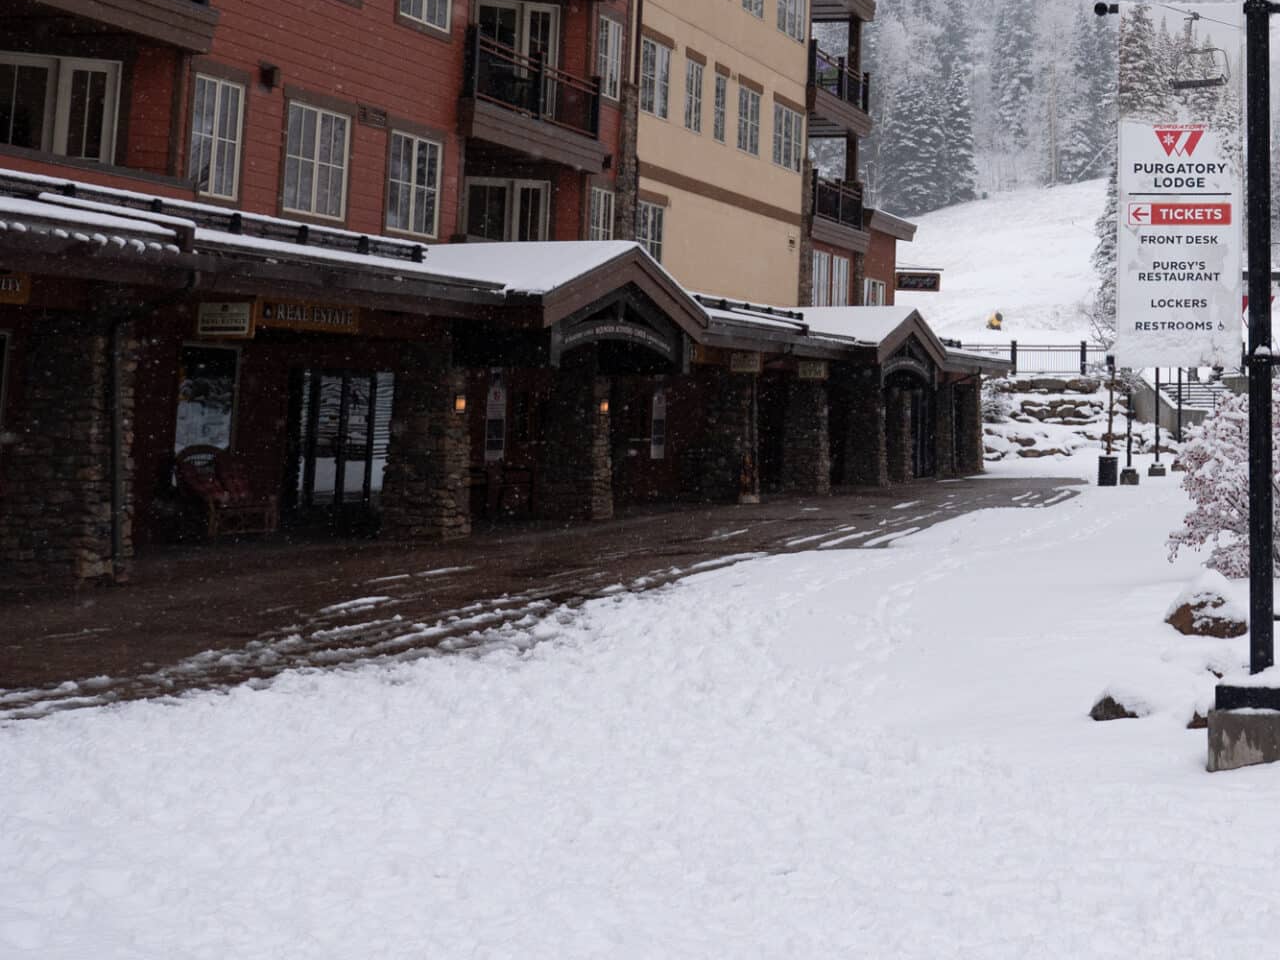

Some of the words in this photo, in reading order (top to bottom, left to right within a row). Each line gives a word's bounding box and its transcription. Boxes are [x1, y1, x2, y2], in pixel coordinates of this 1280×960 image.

[1133, 163, 1227, 174] PURGATORY
[1154, 177, 1205, 188] LODGE
[1159, 208, 1223, 220] TICKETS
[1140, 235, 1182, 245] FRONT
[1186, 235, 1218, 245] DESK
[1152, 260, 1206, 270] PURGY'S
[1138, 271, 1220, 282] RESTAURANT
[1150, 298, 1208, 308] LOCKERS
[276, 303, 308, 321] REAL
[313, 306, 353, 325] ESTATE
[1135, 321, 1213, 331] RESTROOMS
